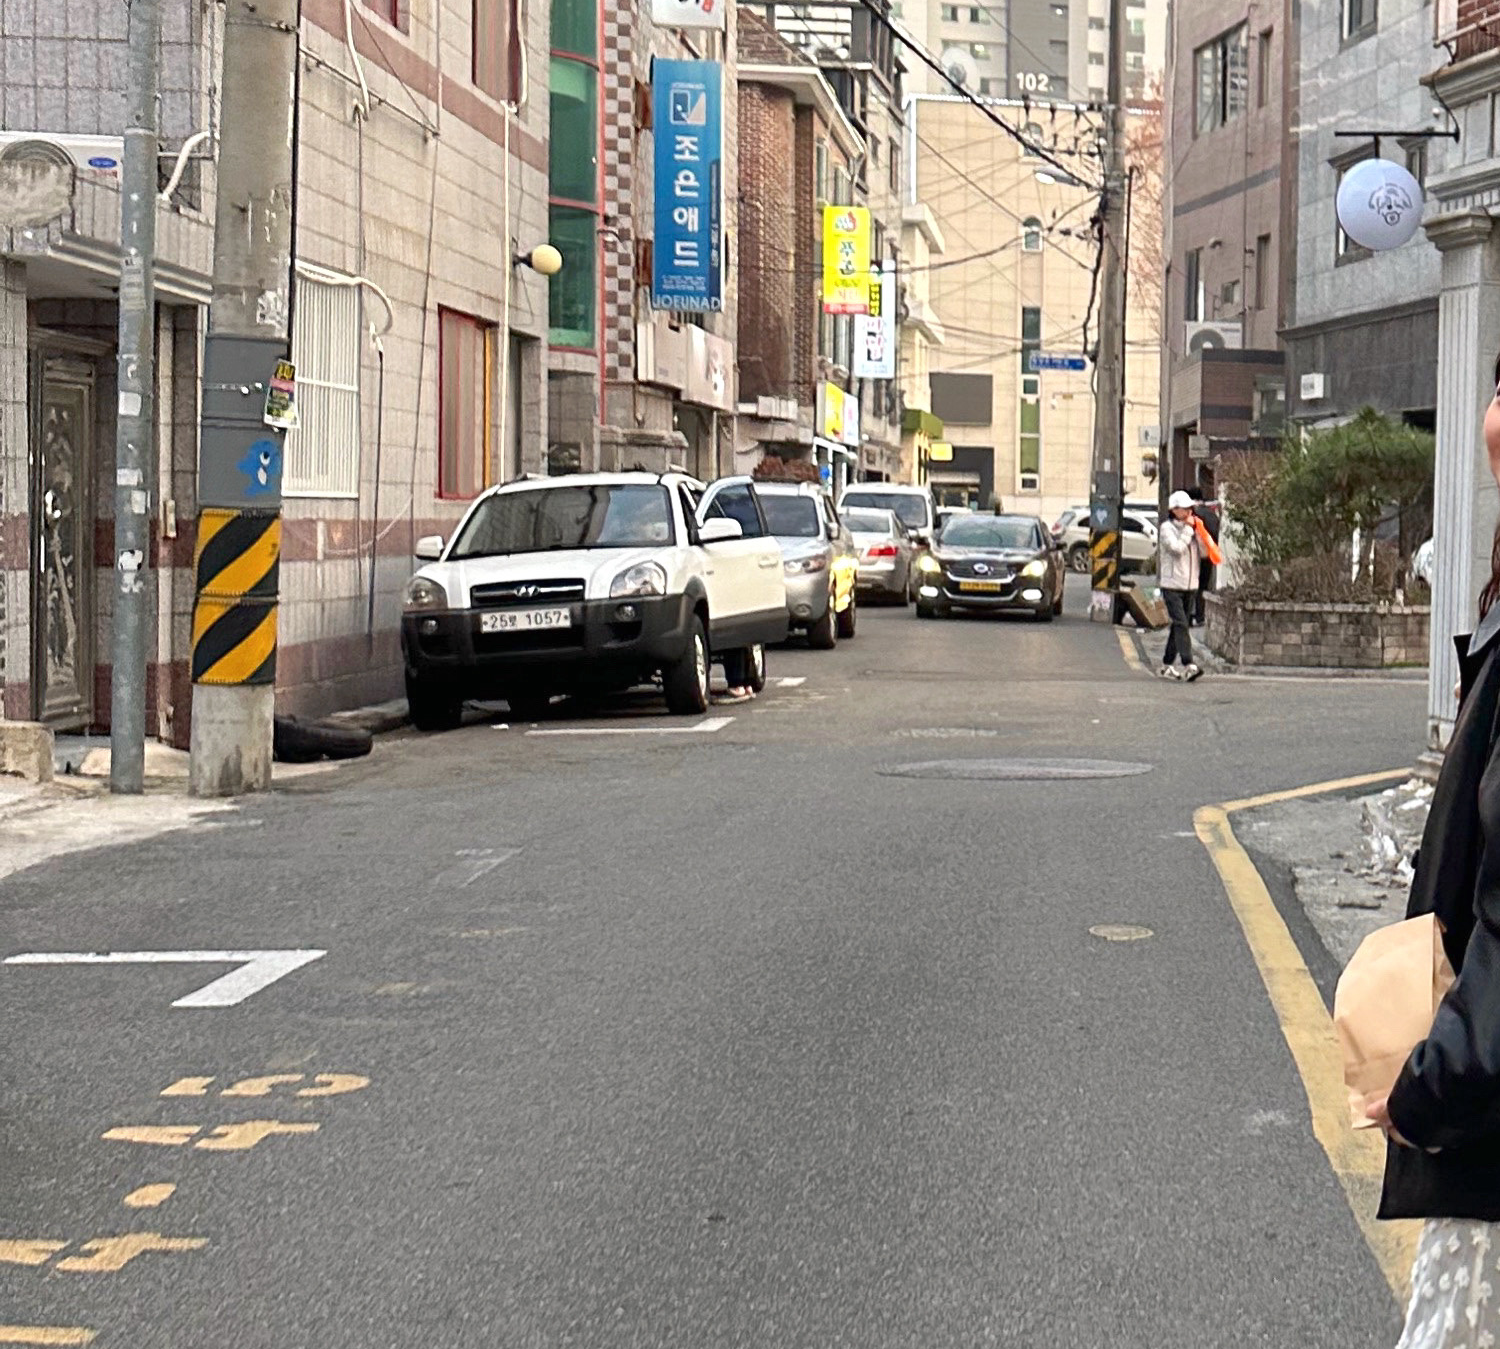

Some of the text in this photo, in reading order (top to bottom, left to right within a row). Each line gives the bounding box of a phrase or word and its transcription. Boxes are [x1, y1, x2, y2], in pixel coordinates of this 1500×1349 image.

[1016, 71, 1049, 91] 102
[673, 135, 700, 267] 조은애드
[653, 294, 720, 311] JOEUNAD
[525, 611, 561, 625] 1057
